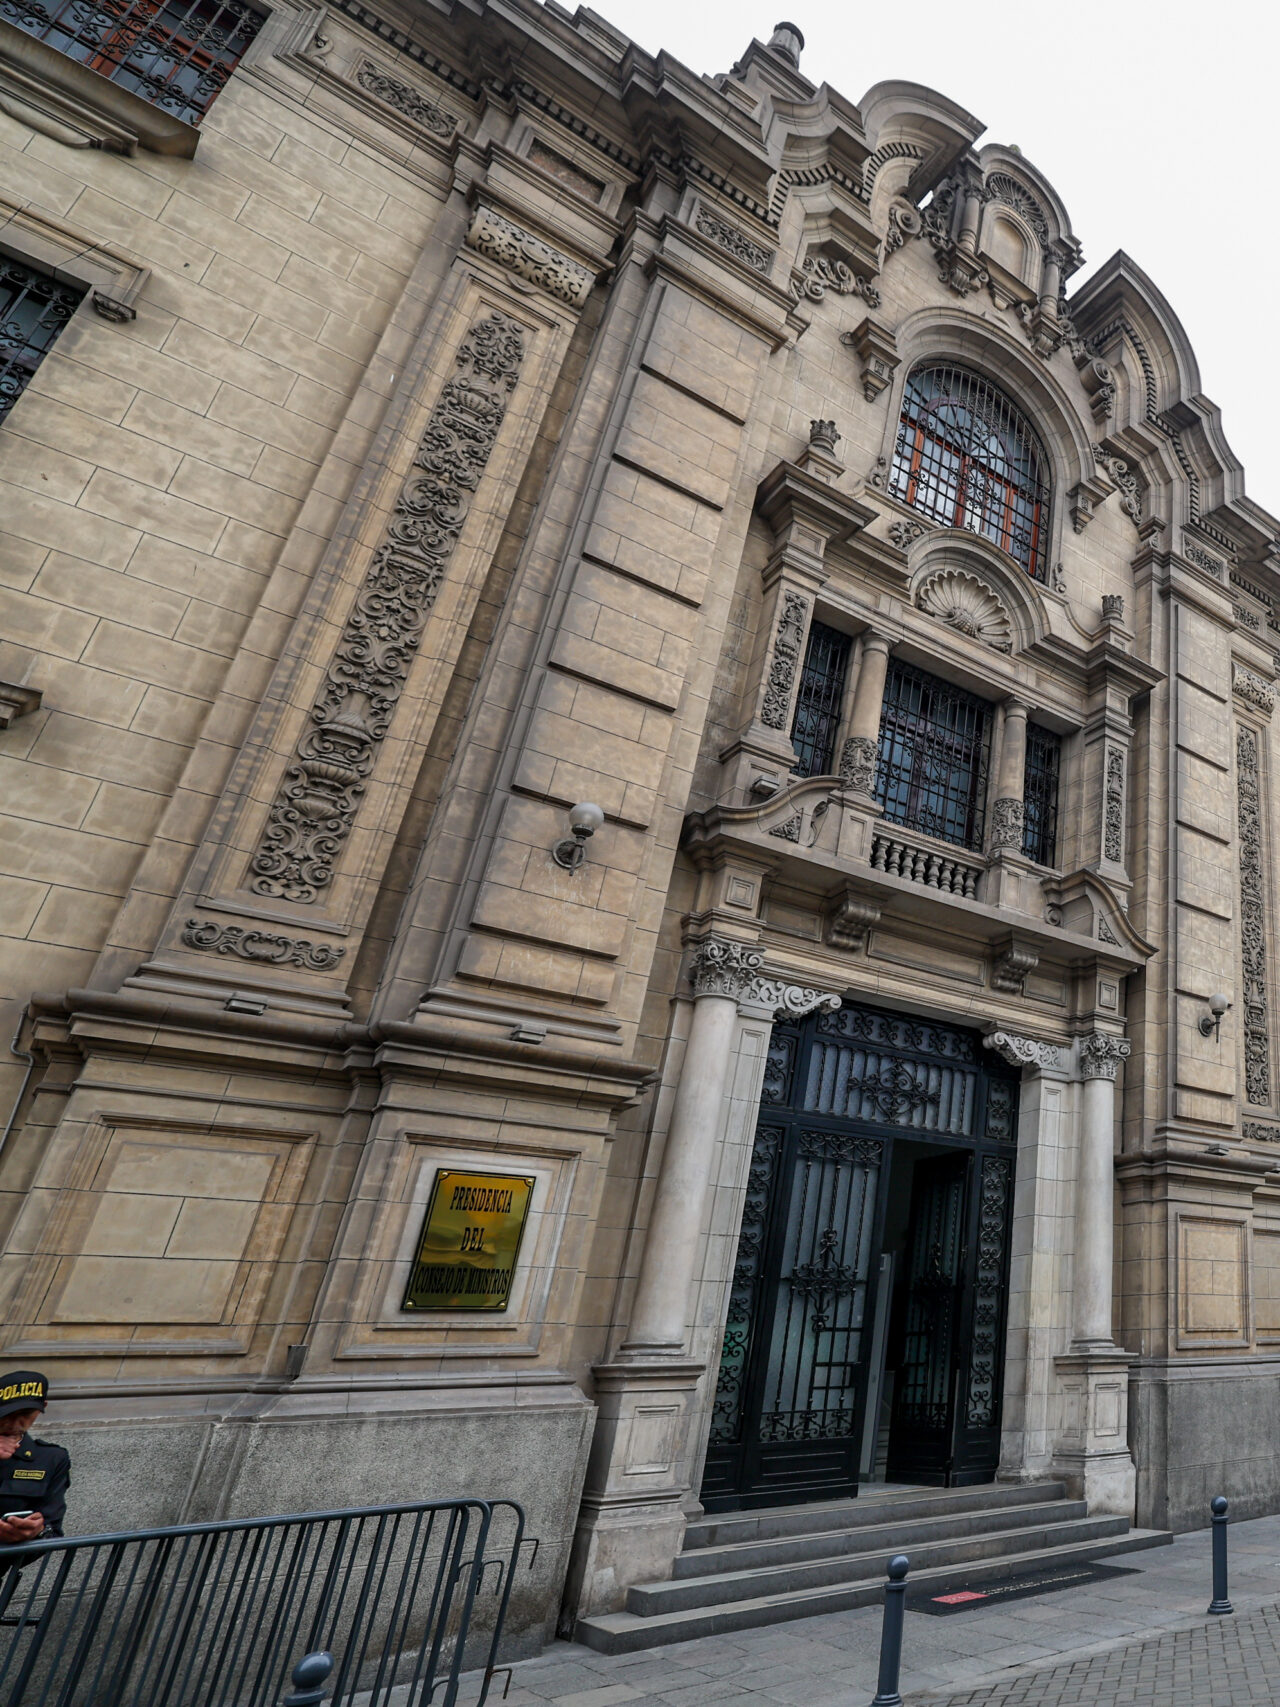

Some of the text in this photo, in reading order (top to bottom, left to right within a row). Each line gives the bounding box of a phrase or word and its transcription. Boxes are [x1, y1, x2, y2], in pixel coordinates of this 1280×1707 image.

[449, 1186, 513, 1213] PRESIDENCIA
[460, 1227, 485, 1252] DEL
[414, 1267, 511, 1295] CONSEJO DE MINISTROS
